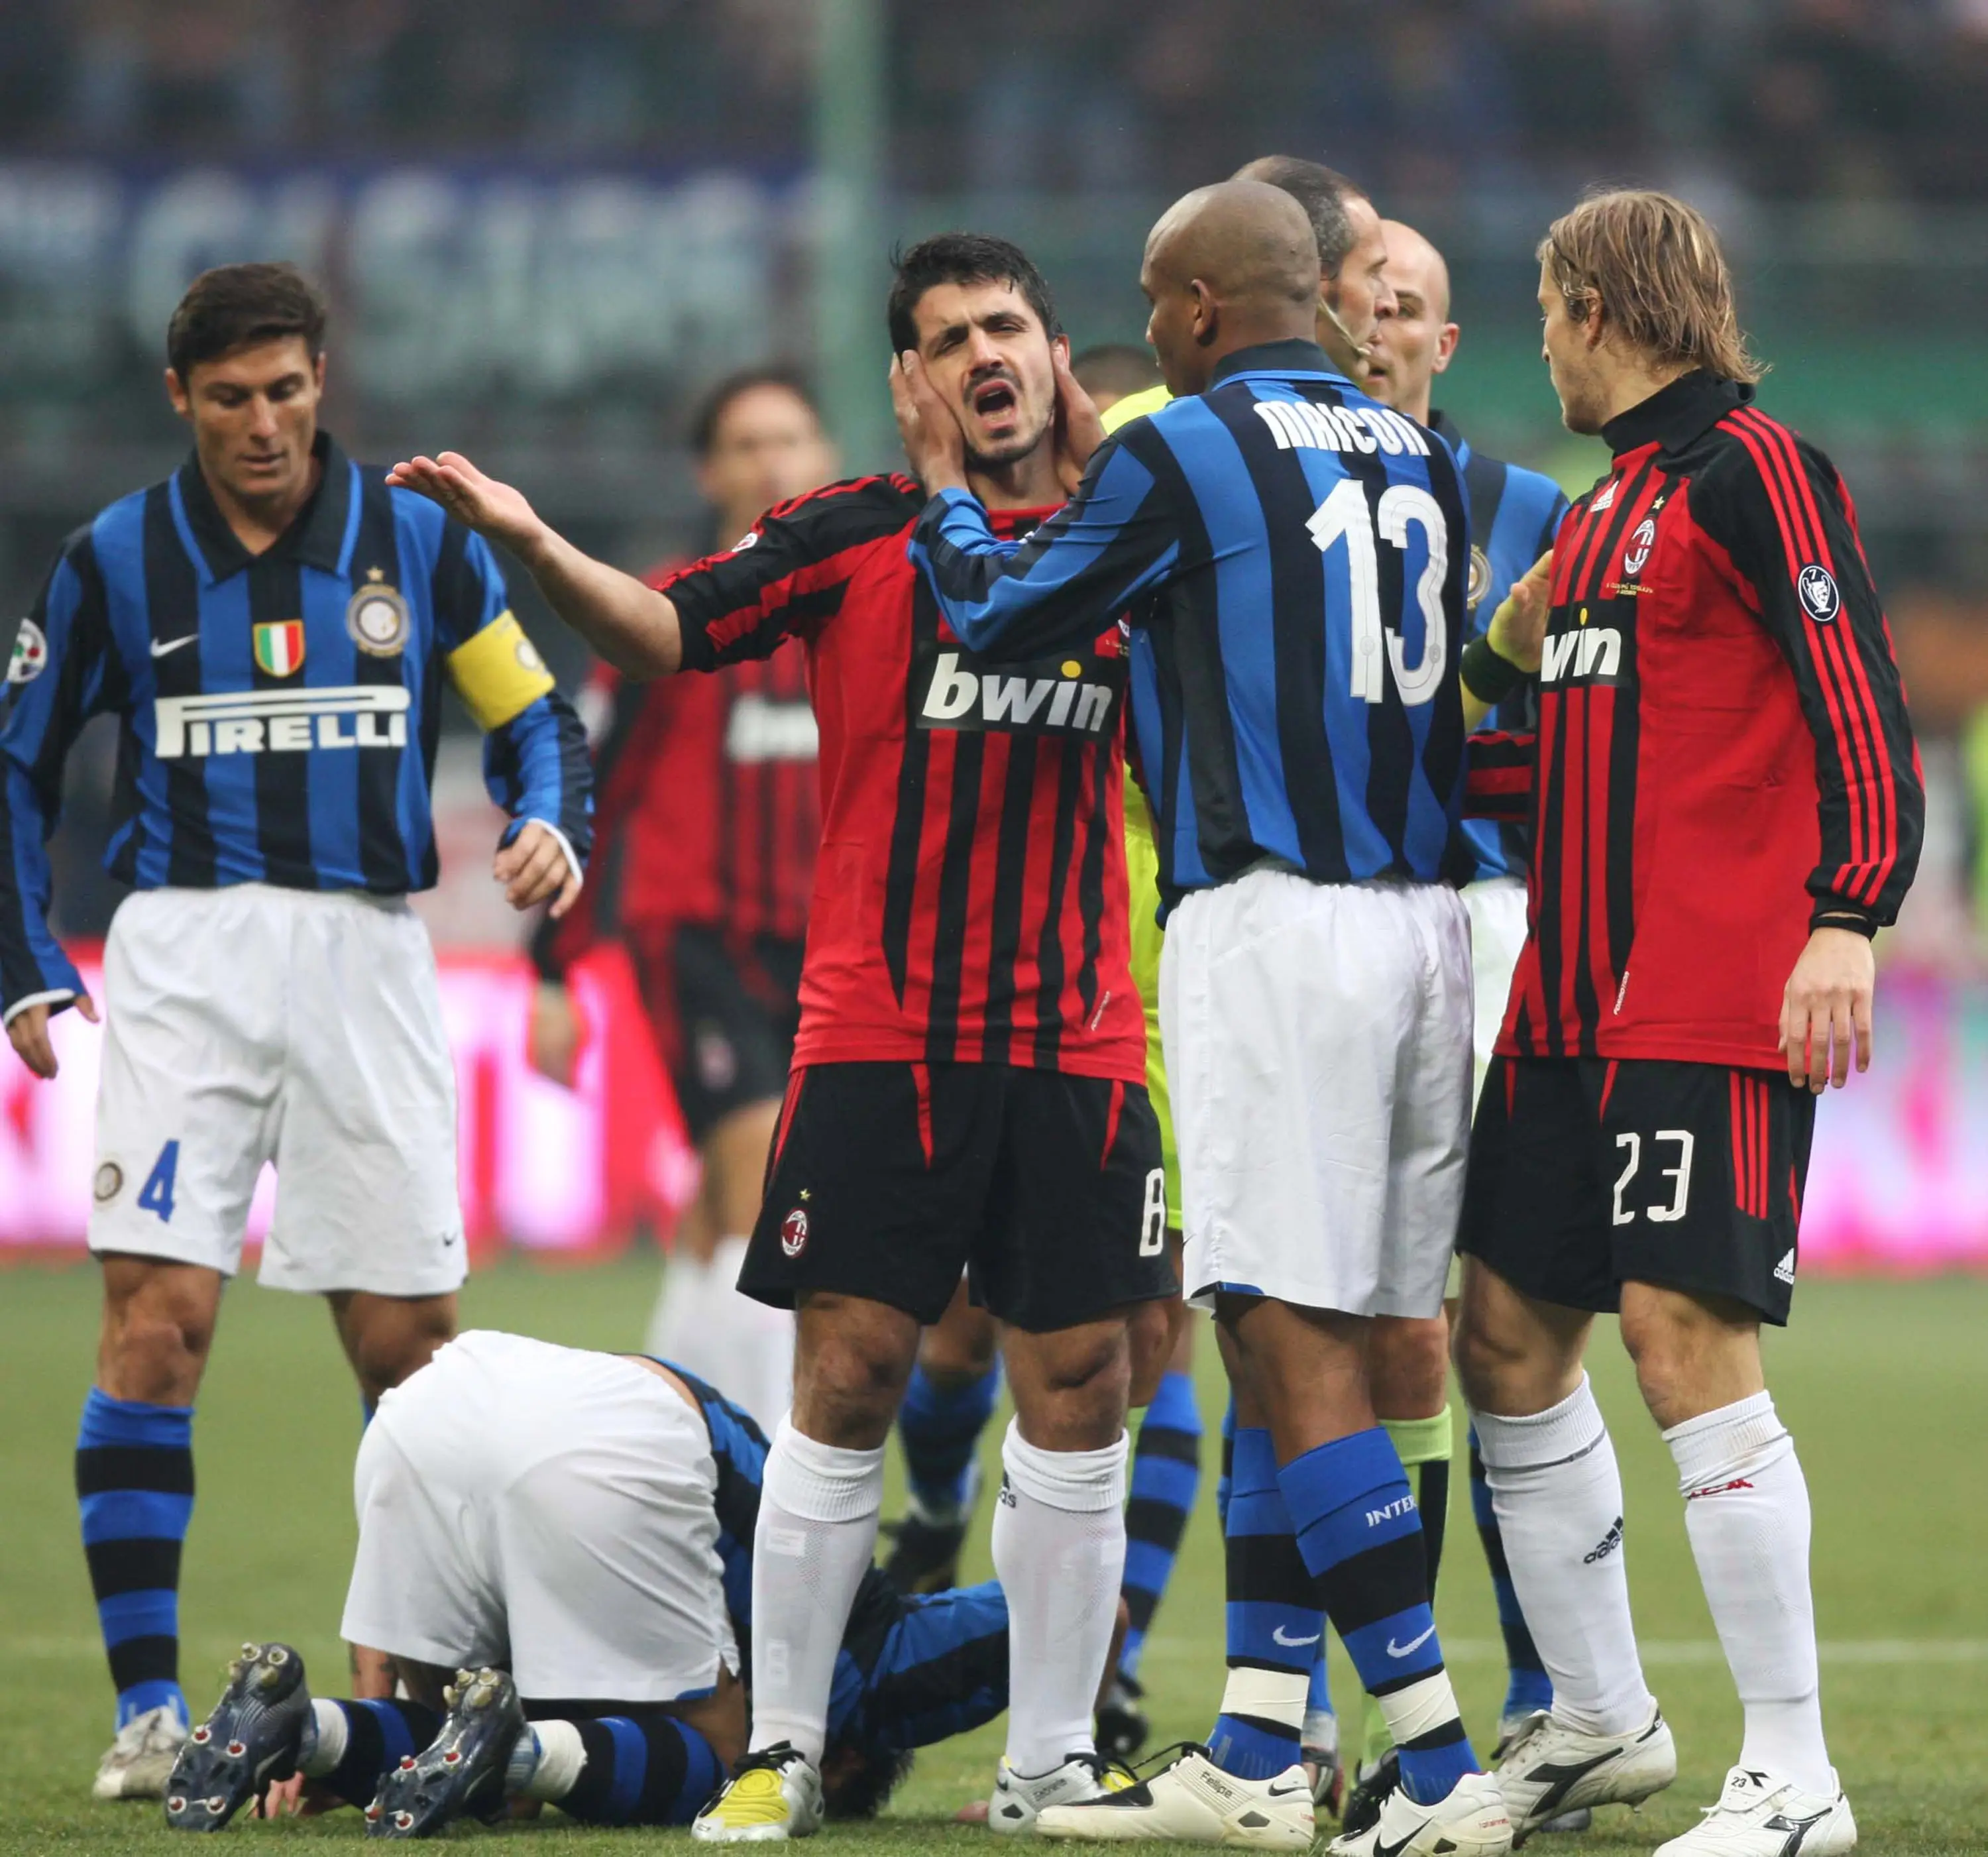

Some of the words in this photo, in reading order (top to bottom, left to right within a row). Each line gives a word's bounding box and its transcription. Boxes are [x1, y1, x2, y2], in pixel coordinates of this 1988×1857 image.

[1254, 400, 1431, 457] MAICON
[1305, 478, 1448, 706] 13
[1808, 569, 1817, 581] 7
[154, 685, 411, 759] PIRELLI
[922, 652, 1114, 732] bwin
[137, 1139, 180, 1224] 4
[1139, 1167, 1166, 1257] 8
[1612, 1129, 1695, 1226] 23
[1366, 1494, 1418, 1528] INTER
[1730, 1776, 1747, 1788] 23
